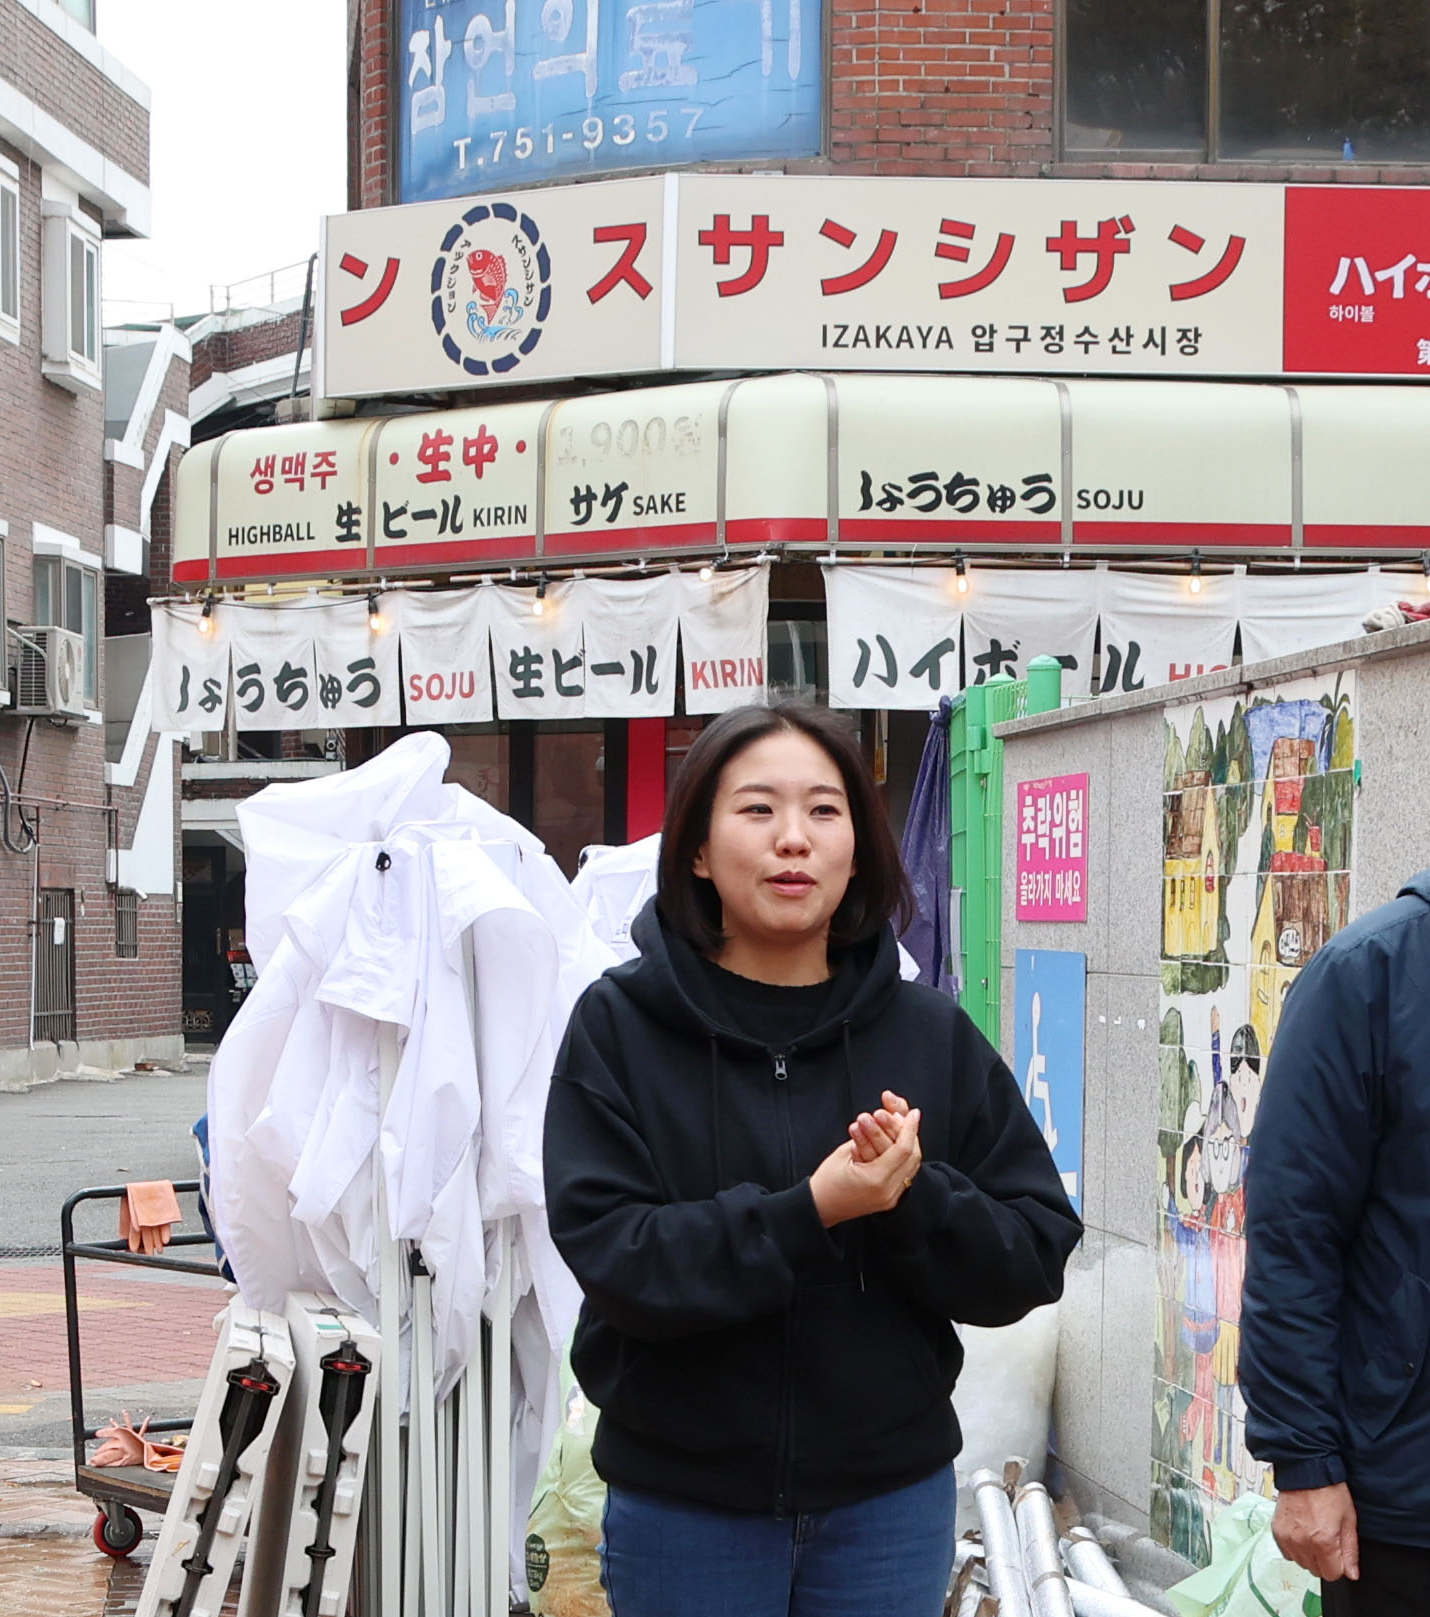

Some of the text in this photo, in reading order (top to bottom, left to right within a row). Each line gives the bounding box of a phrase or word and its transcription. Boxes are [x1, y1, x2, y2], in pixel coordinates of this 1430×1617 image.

[1329, 305, 1375, 323] 하이볼
[821, 324, 954, 350] IZAKAYA
[249, 449, 339, 496] 생맥주
[569, 480, 629, 524] サケ
[632, 492, 687, 516] SAKE
[1076, 488, 1144, 511] SOJU
[473, 503, 527, 528] KIRIN
[227, 519, 316, 547] HIGHBALL
[409, 671, 475, 702] SOJU
[509, 645, 764, 699] 生ビール KIRIN
[1021, 789, 1083, 862] 추락위험
[1020, 869, 1081, 907] 올라가지 마세요
